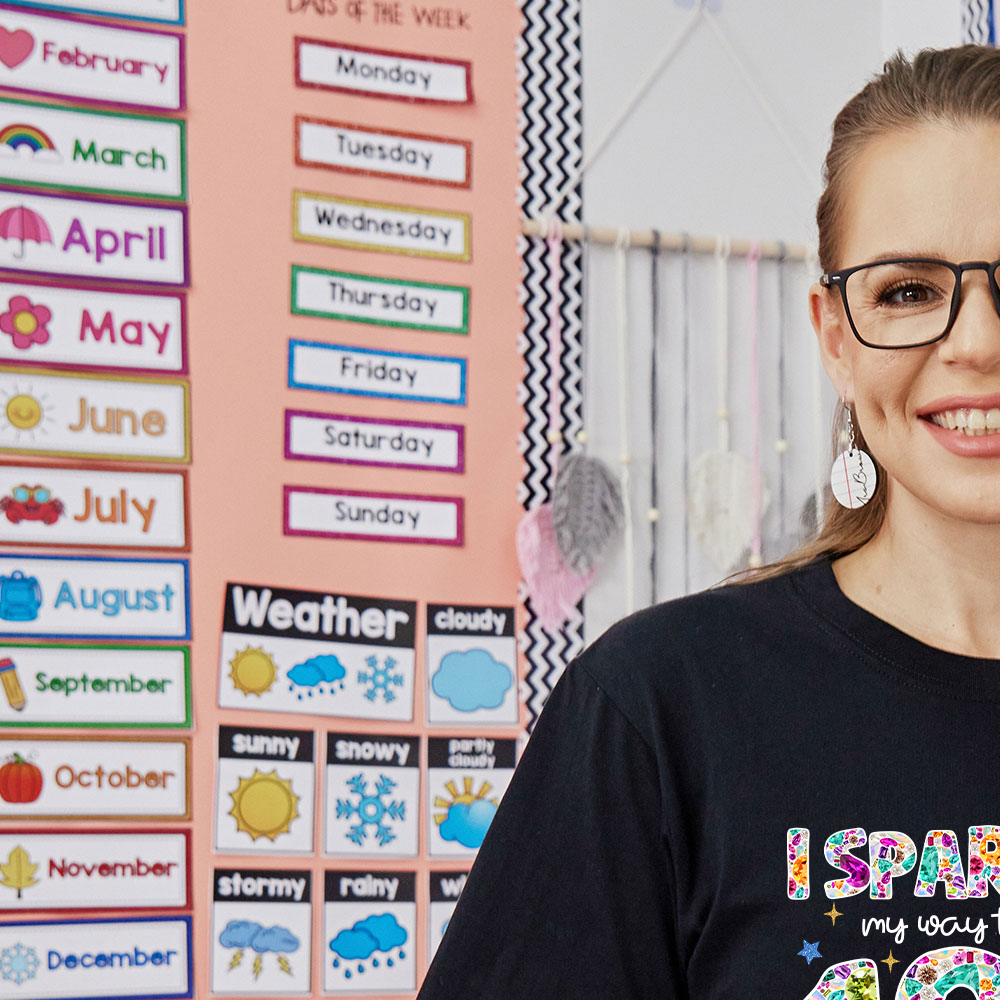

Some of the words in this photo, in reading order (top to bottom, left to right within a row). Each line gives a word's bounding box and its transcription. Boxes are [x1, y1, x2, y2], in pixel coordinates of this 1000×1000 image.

[346, 0, 366, 23] OF
[373, 2, 402, 25] THE
[412, 6, 471, 30] WEEK
[42, 41, 168, 83] February
[336, 55, 432, 90] Monday
[72, 138, 167, 171] March
[336, 134, 433, 169] Tuesday
[62, 218, 167, 262] April
[315, 207, 451, 245] Wednesday
[328, 282, 437, 318] Thursday
[79, 309, 169, 354] May
[340, 356, 417, 387] Friday
[69, 397, 167, 437] June
[324, 425, 434, 456] Saturday
[74, 487, 156, 532] July
[335, 502, 420, 530] Sunday
[54, 581, 174, 616] August
[231, 586, 409, 640] Weather
[434, 608, 506, 634] cloudy
[35, 672, 172, 696] September
[232, 733, 300, 757] sunny
[335, 741, 410, 763] snowy
[448, 752, 496, 768] cloudy
[55, 765, 175, 790] October
[49, 858, 178, 878] November
[787, 827, 810, 900] I
[218, 874, 306, 898] stormy
[340, 874, 399, 898] rainy
[861, 912, 909, 943] my
[917, 912, 988, 943] way
[47, 947, 177, 970] December
